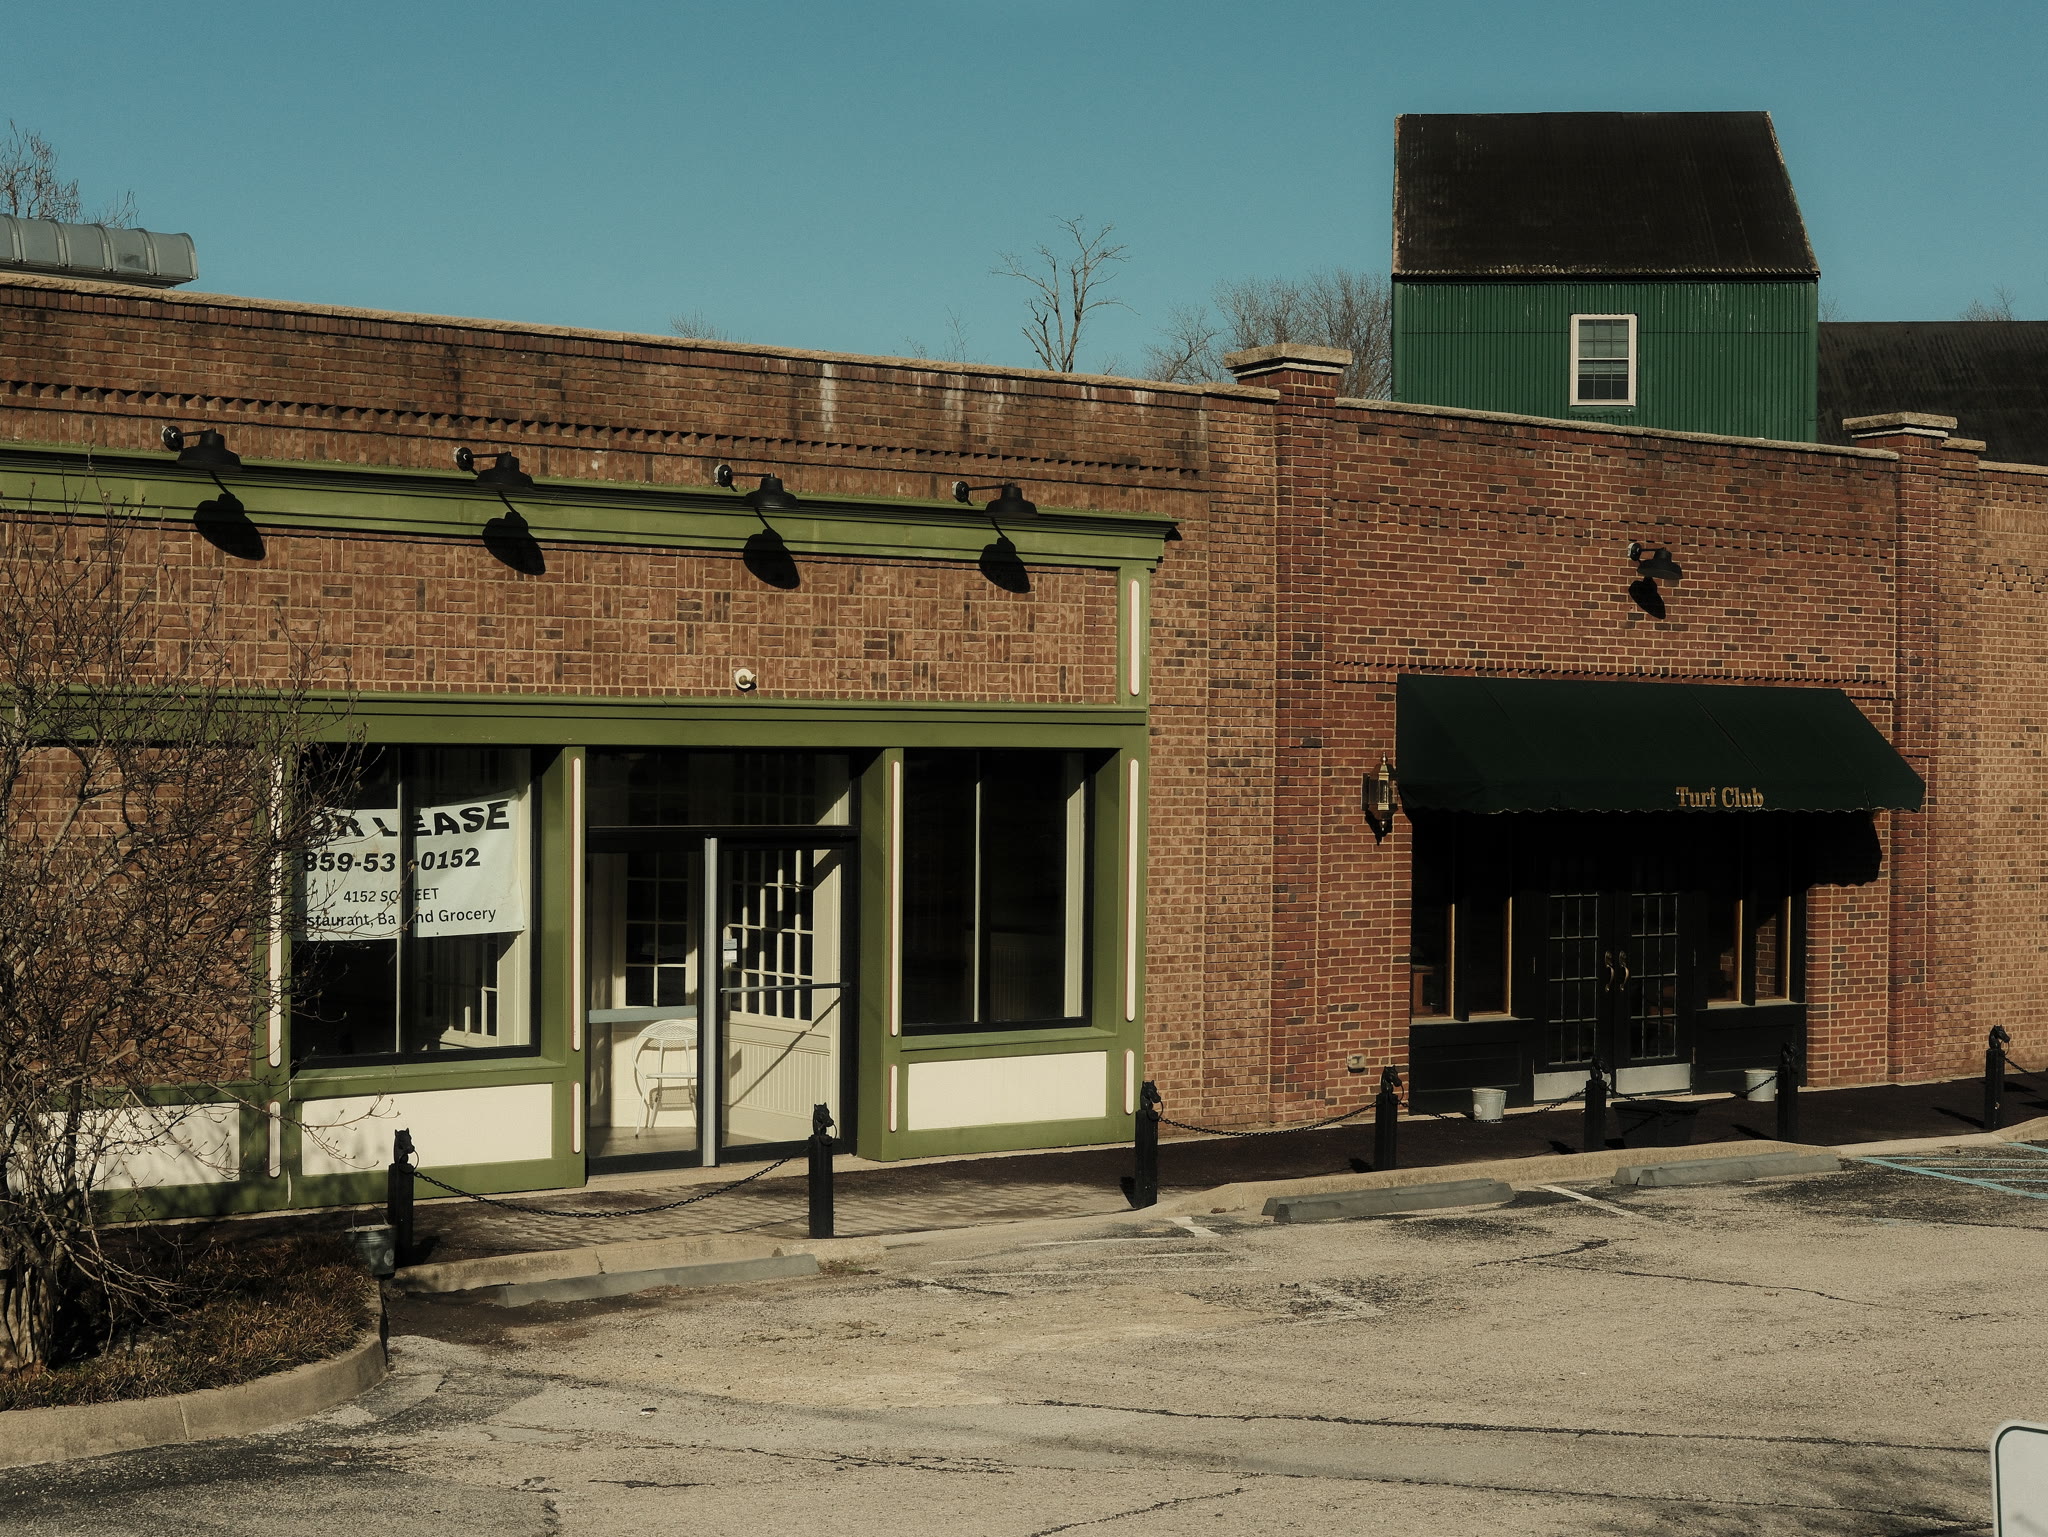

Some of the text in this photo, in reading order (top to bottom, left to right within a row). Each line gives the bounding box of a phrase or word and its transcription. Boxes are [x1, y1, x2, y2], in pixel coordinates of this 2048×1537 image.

[1675, 786, 1764, 808] Turf Club
[303, 847, 481, 872] 859-53-0152
[343, 890, 377, 903] 4152
[411, 888, 439, 901] EET
[303, 909, 497, 929] staurant, Ba nd Grocery
